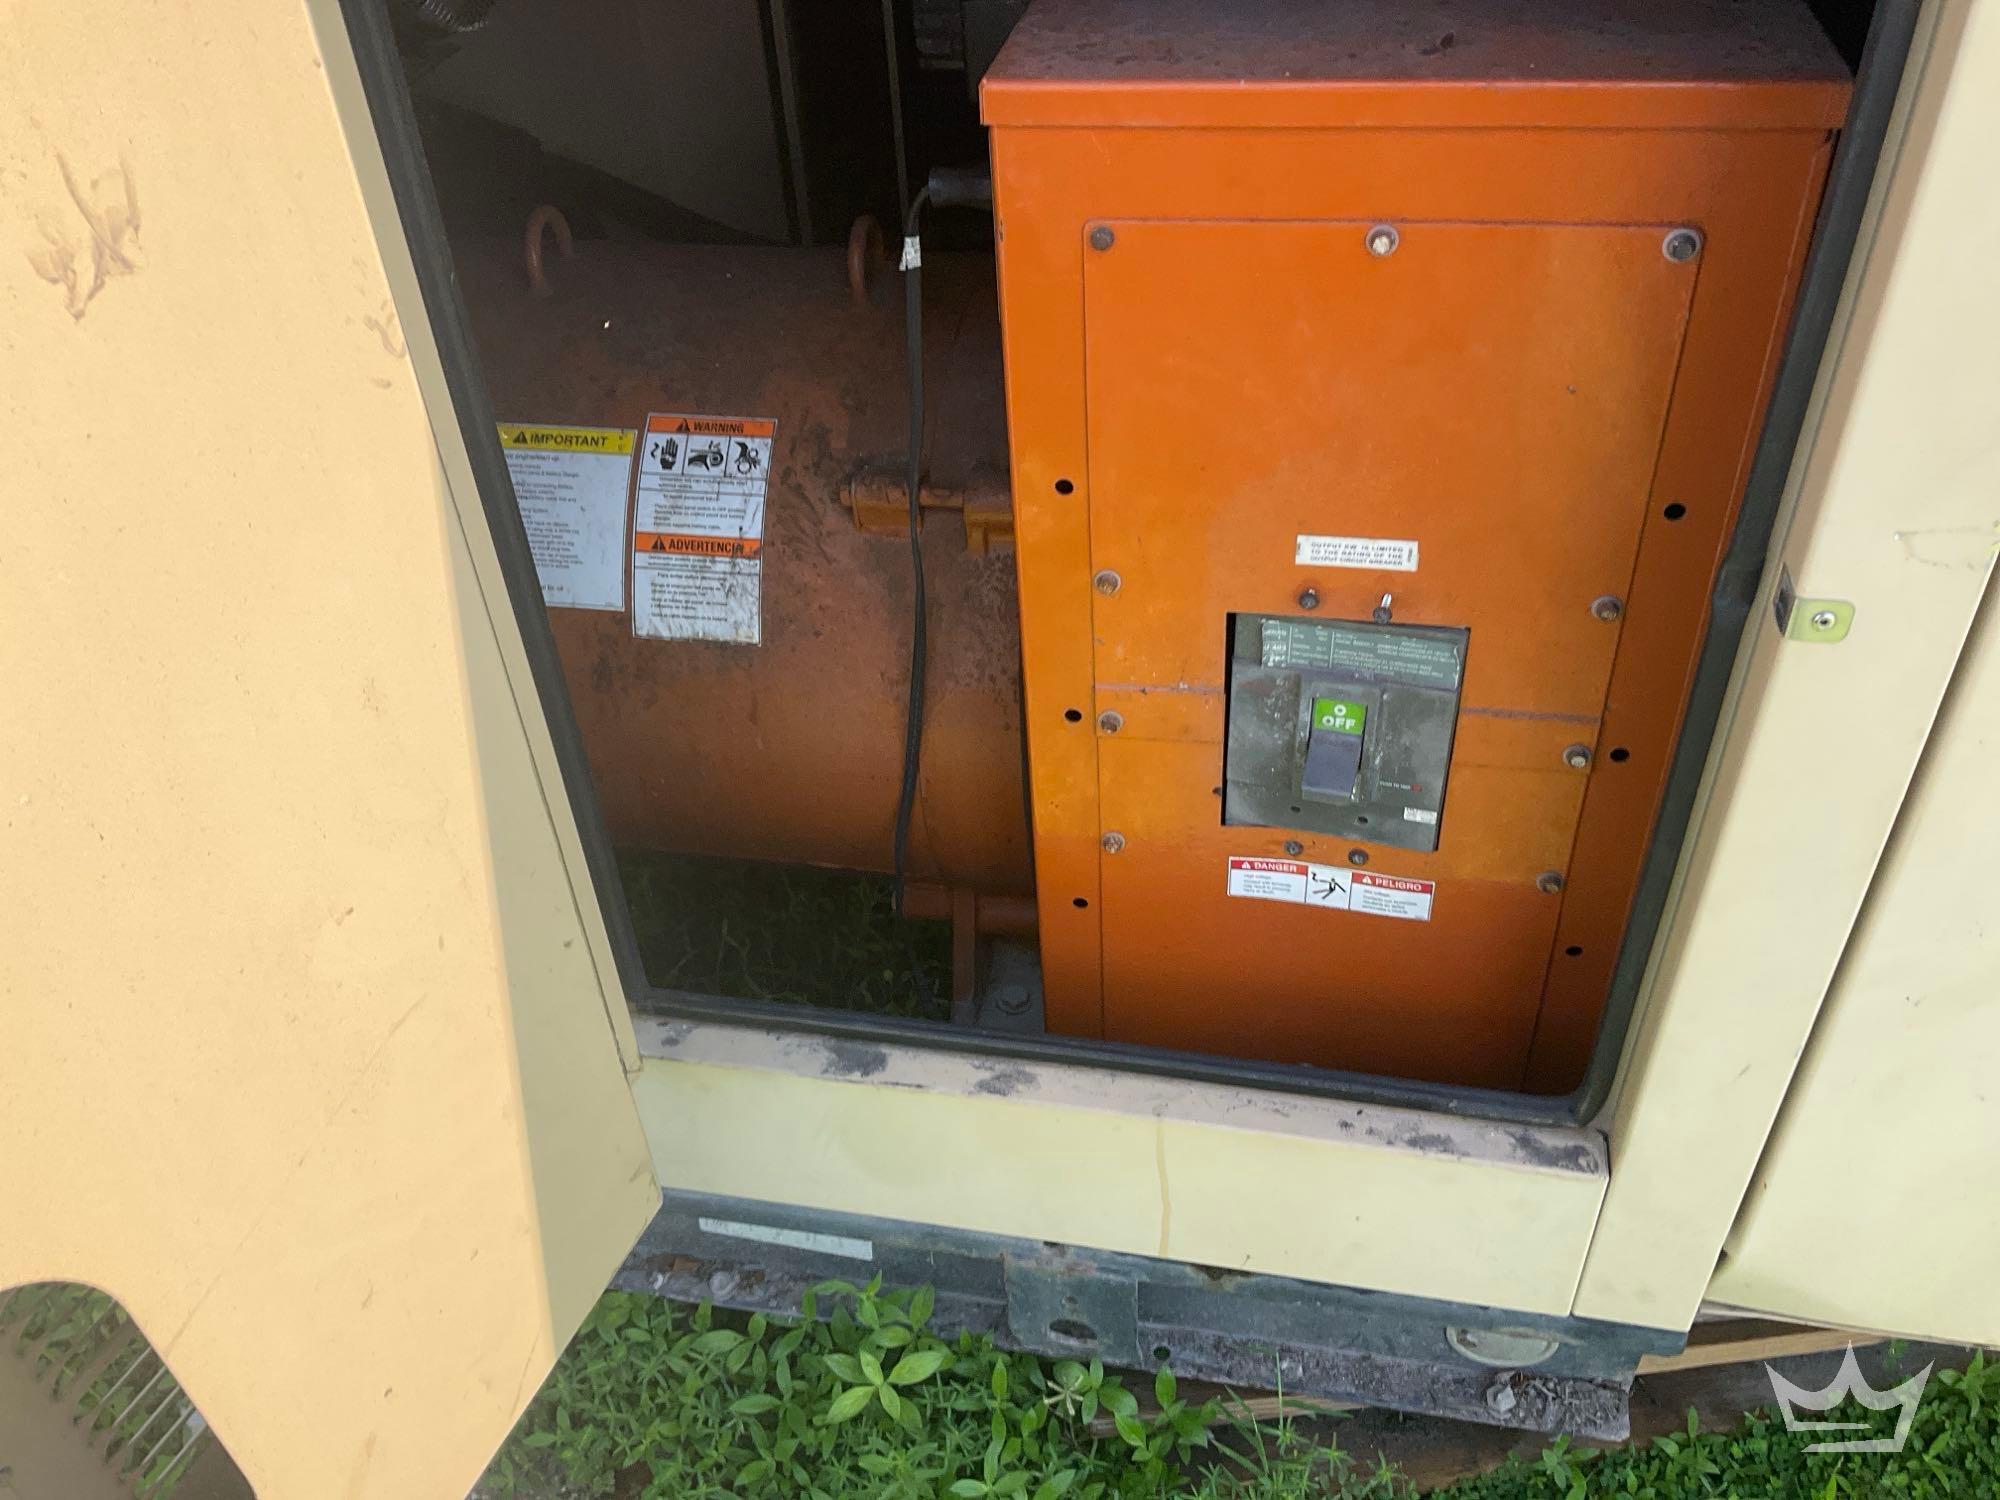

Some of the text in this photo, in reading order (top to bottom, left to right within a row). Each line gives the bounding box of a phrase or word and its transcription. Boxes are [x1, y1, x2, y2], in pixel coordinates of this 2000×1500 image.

[693, 422, 744, 434] WARNING
[530, 432, 608, 447] IMPORTANT
[1321, 715, 1356, 730] OFF
[1254, 862, 1297, 873] DANGER
[1375, 877, 1422, 892] PELIGRO
